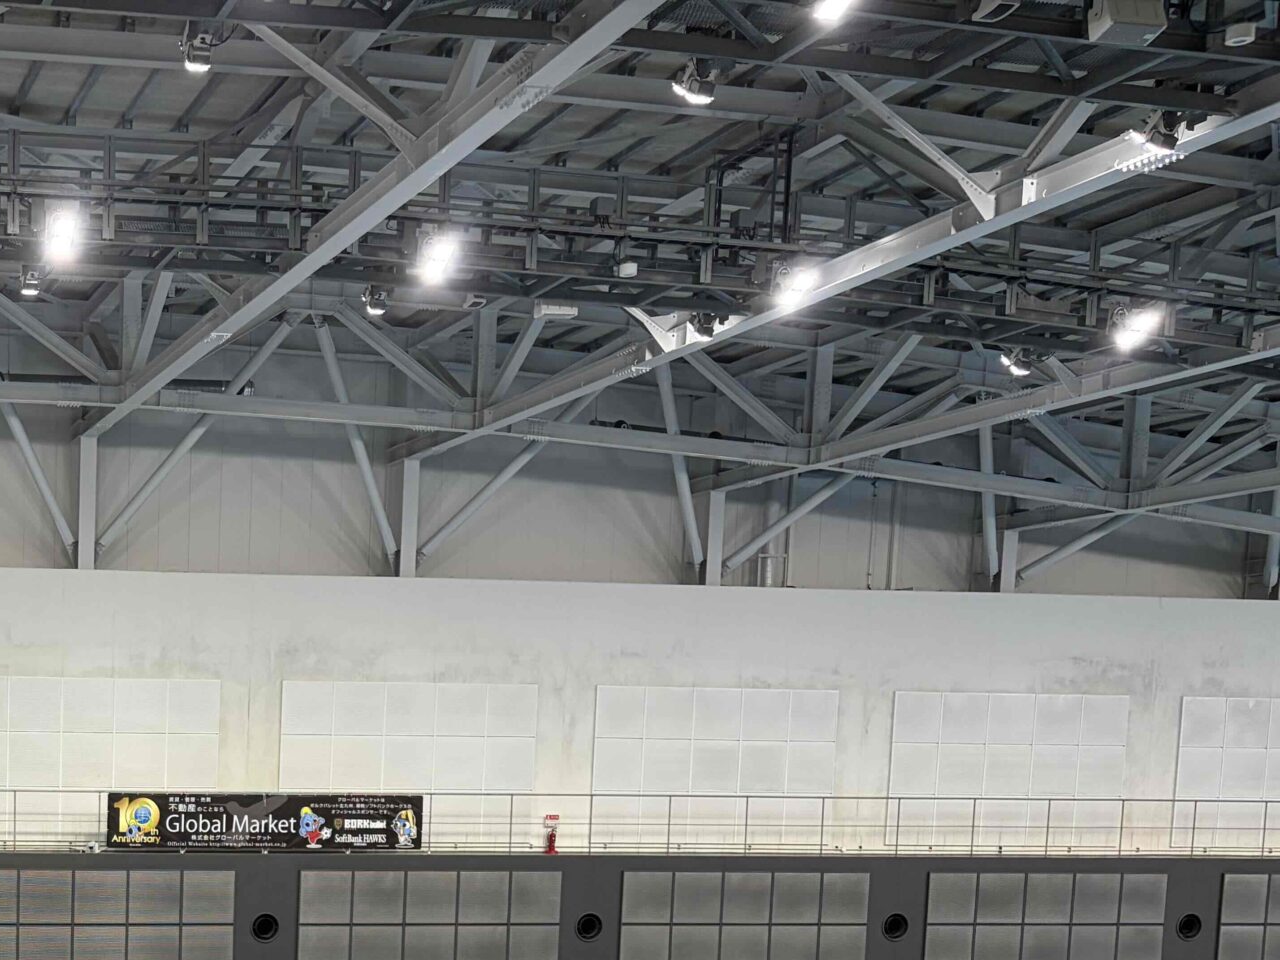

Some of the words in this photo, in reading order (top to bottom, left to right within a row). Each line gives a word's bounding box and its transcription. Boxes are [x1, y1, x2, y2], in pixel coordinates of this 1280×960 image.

[168, 803, 224, 813] 不動産のことなら
[165, 813, 227, 833] Global
[231, 813, 297, 834] Market
[111, 834, 161, 845] Anniversary
[334, 833, 362, 844] SoftBank
[363, 833, 387, 844] HAWKS
